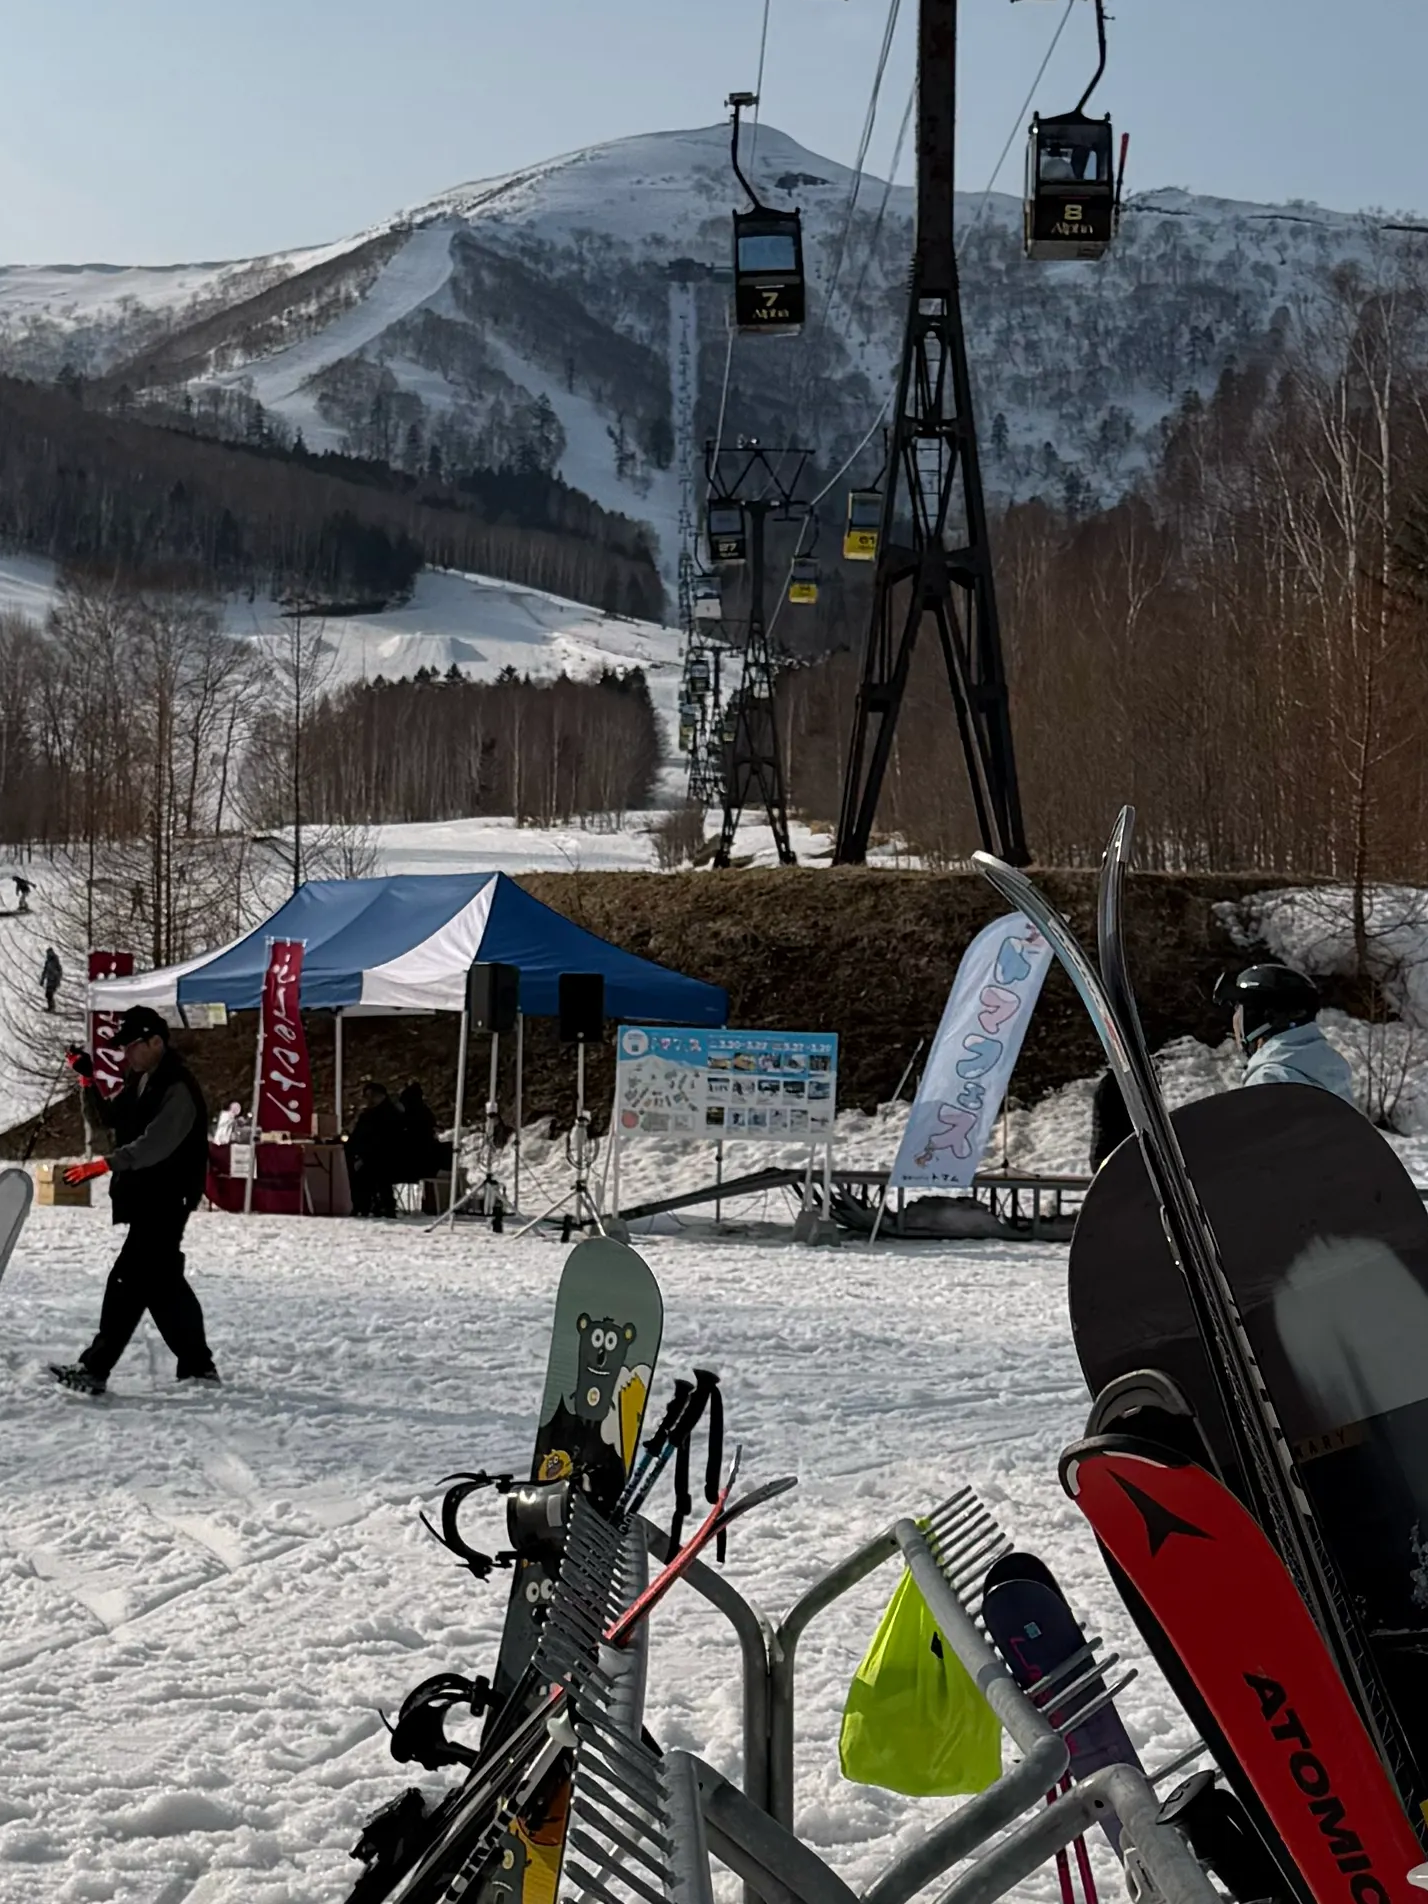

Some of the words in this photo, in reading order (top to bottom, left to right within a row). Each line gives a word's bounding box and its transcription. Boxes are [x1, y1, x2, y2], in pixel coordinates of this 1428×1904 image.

[1063, 204, 1083, 220] 8
[761, 292, 779, 307] 7
[928, 936, 1032, 1159] トマフェス
